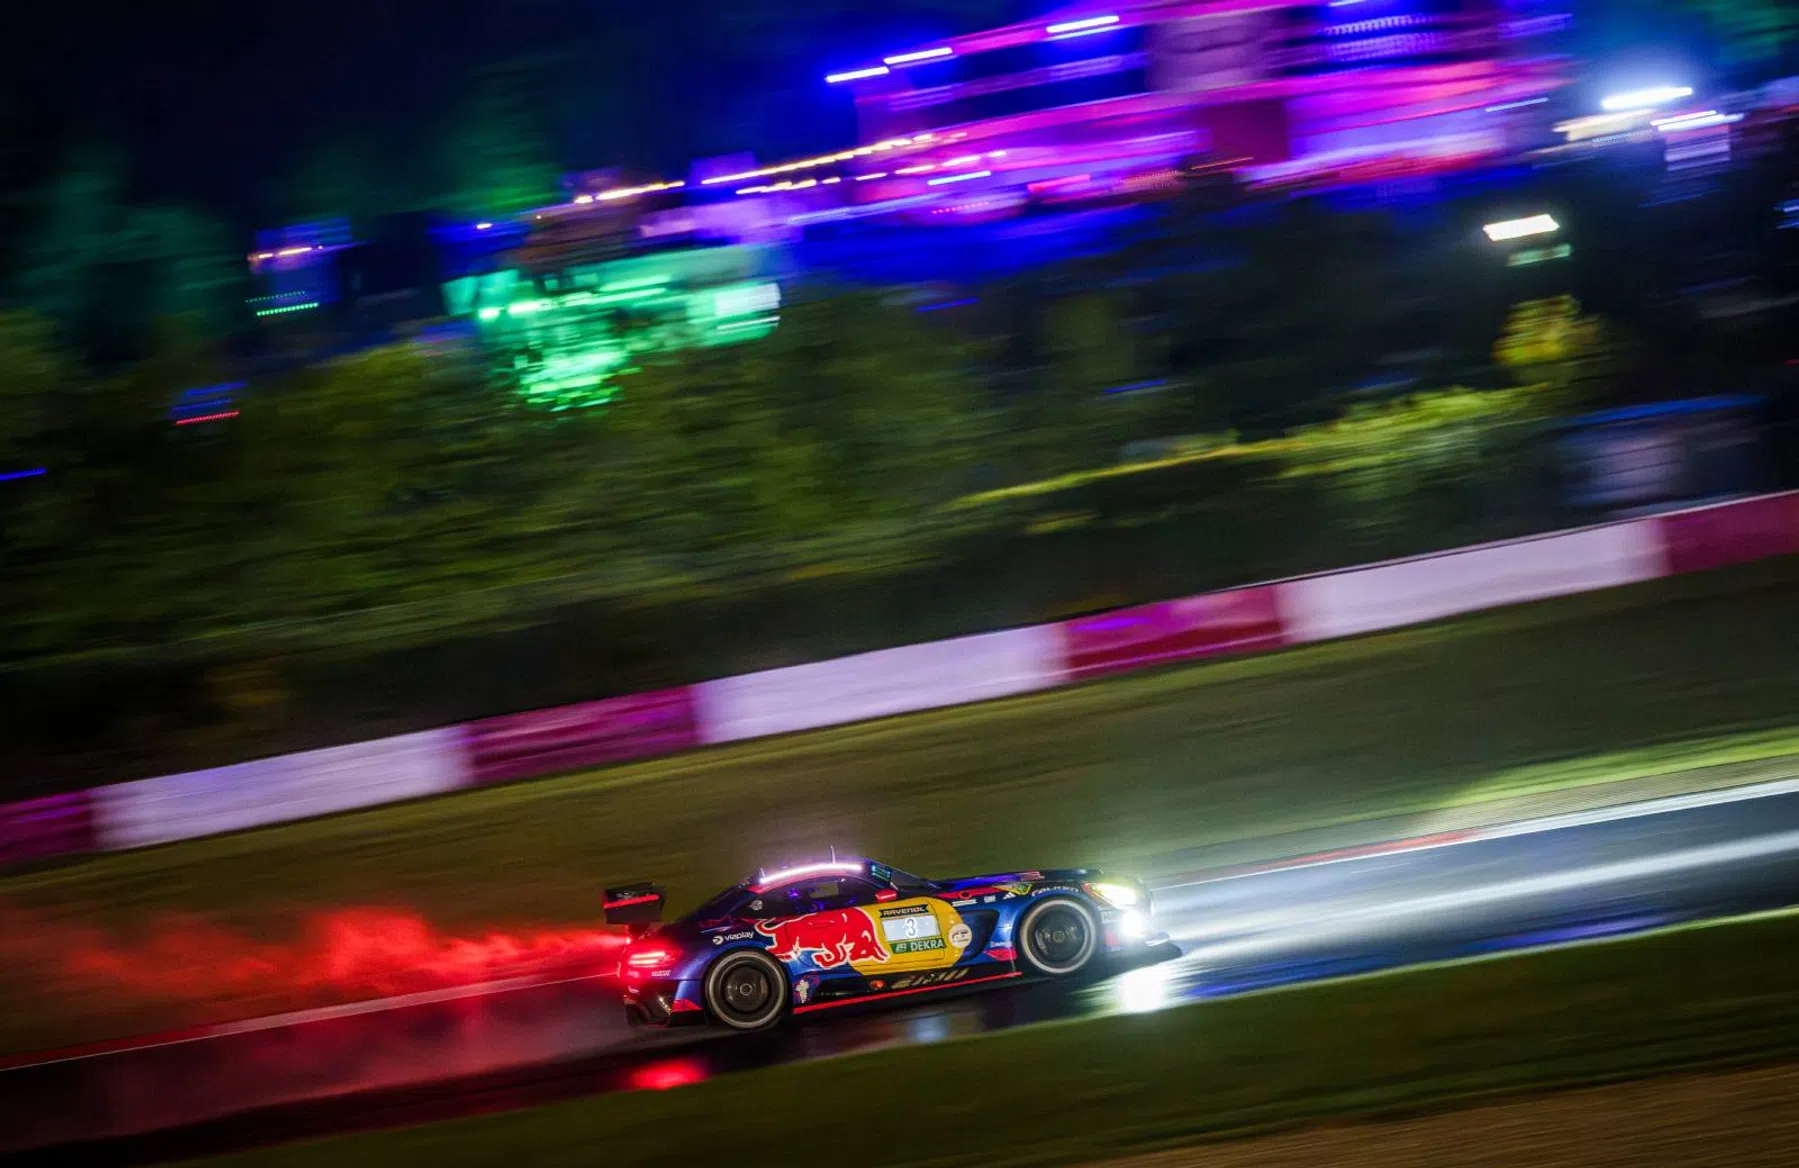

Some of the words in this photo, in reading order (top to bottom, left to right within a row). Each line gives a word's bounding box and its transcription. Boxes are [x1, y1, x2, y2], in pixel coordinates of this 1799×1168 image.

[883, 907, 925, 916] RAVENOL
[906, 917, 918, 938] 3
[724, 931, 755, 942] viaplay
[910, 940, 946, 951] DEKRA
